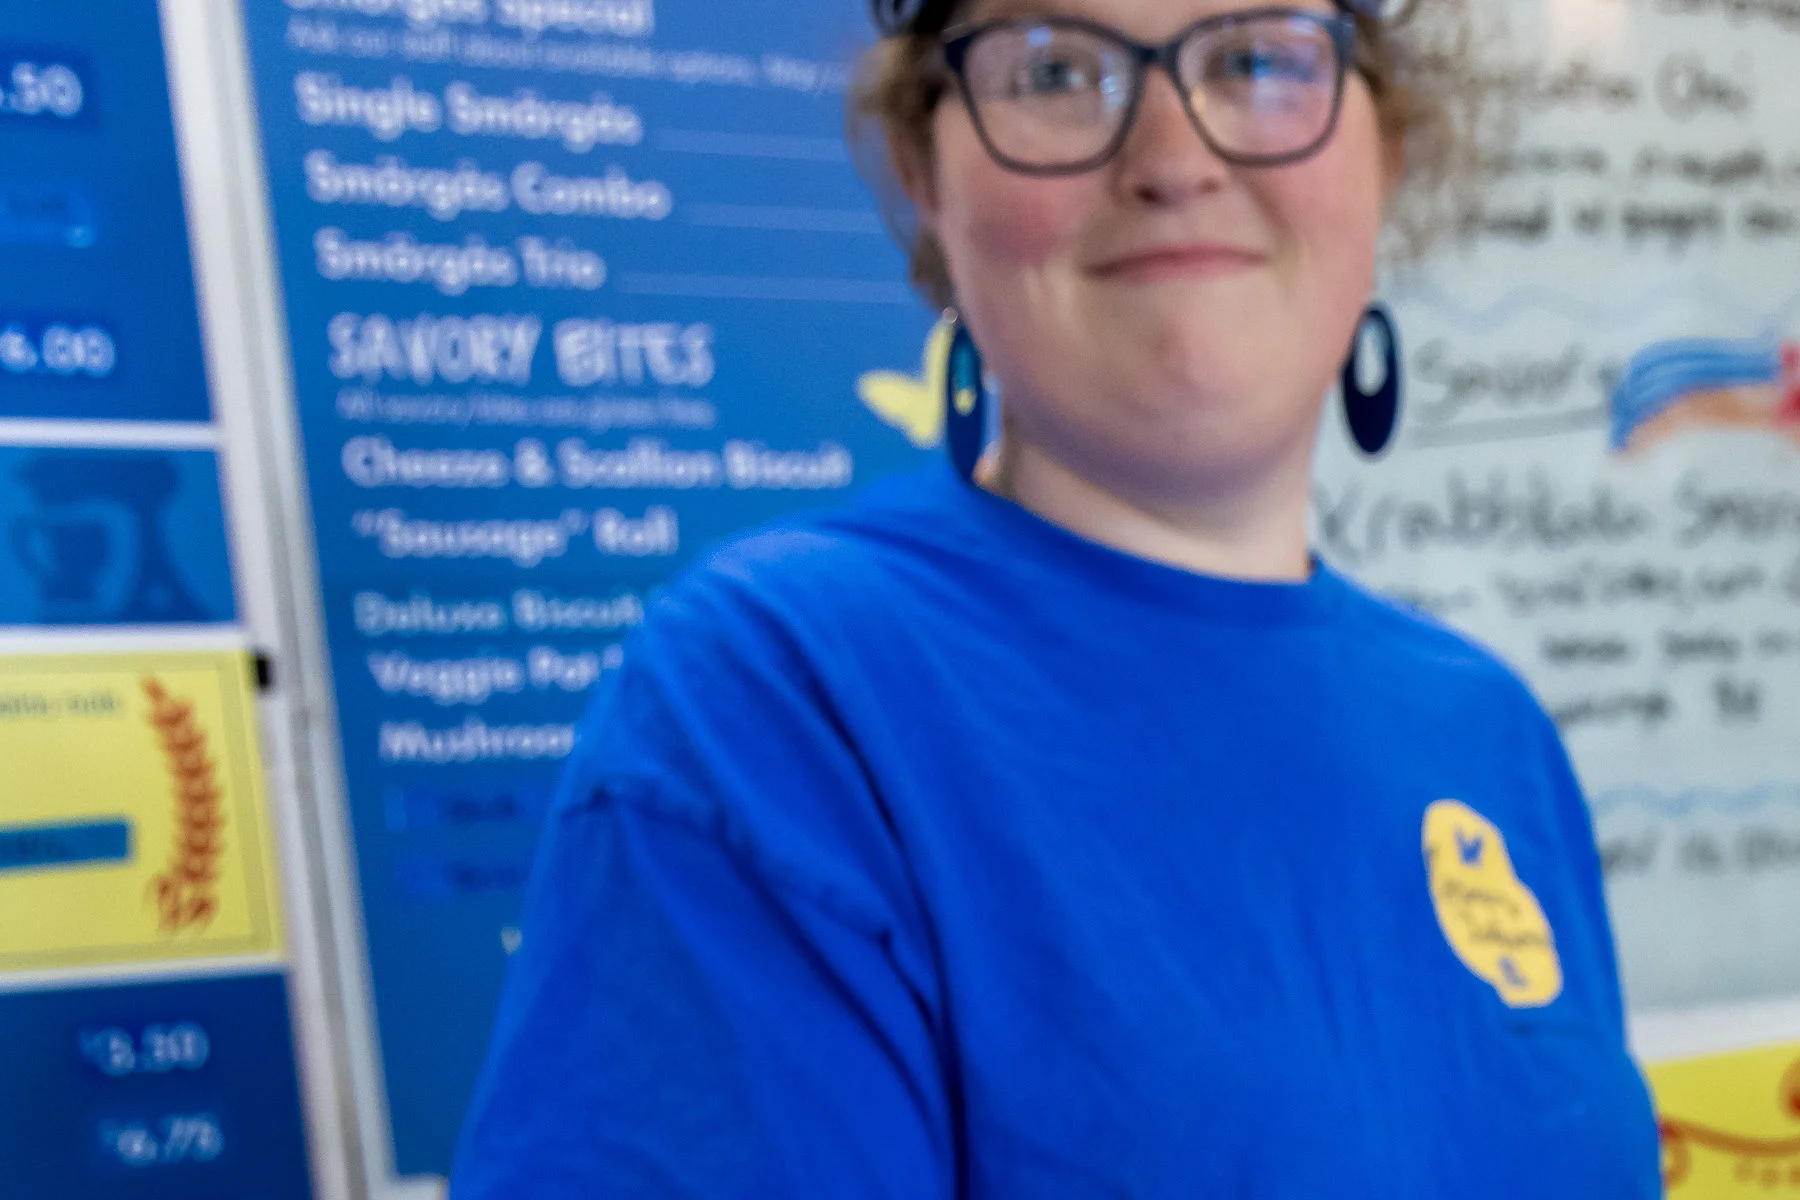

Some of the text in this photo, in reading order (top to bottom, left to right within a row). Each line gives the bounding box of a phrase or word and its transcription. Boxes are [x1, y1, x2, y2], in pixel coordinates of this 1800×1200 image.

[514, 164, 669, 218] Combo
[521, 238, 603, 287] Trio
[330, 316, 714, 384] SAVORY BITES
[596, 509, 676, 554] Roll
